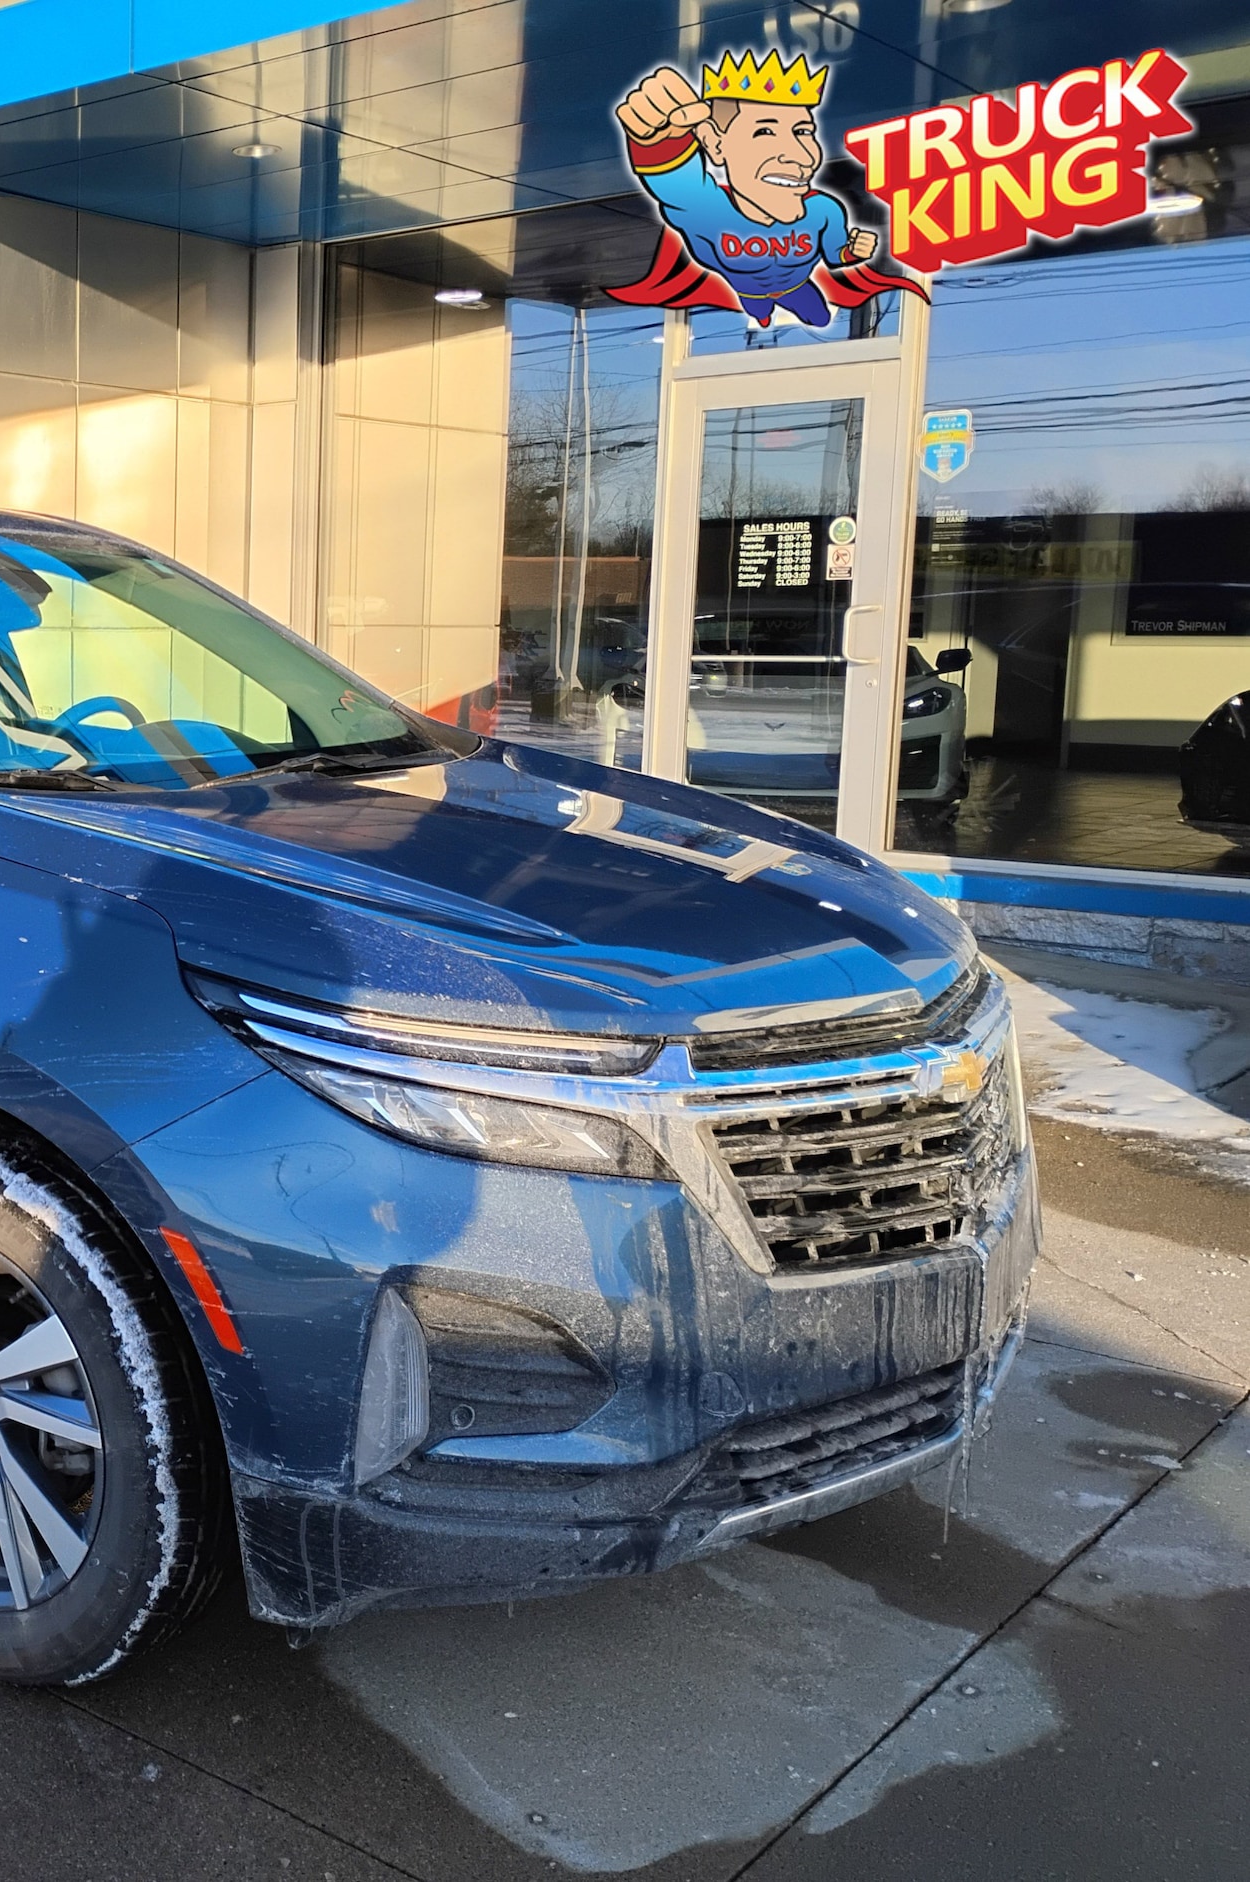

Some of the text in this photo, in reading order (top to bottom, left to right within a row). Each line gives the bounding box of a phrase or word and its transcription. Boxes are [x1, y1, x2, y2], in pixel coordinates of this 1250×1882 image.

[743, 521, 810, 533] SALES HOURS
[740, 535, 766, 543] Monday
[738, 565, 758, 573] Friday
[737, 580, 761, 588] Sunday
[1131, 620, 1227, 632] TREVOR SHIPMAN
